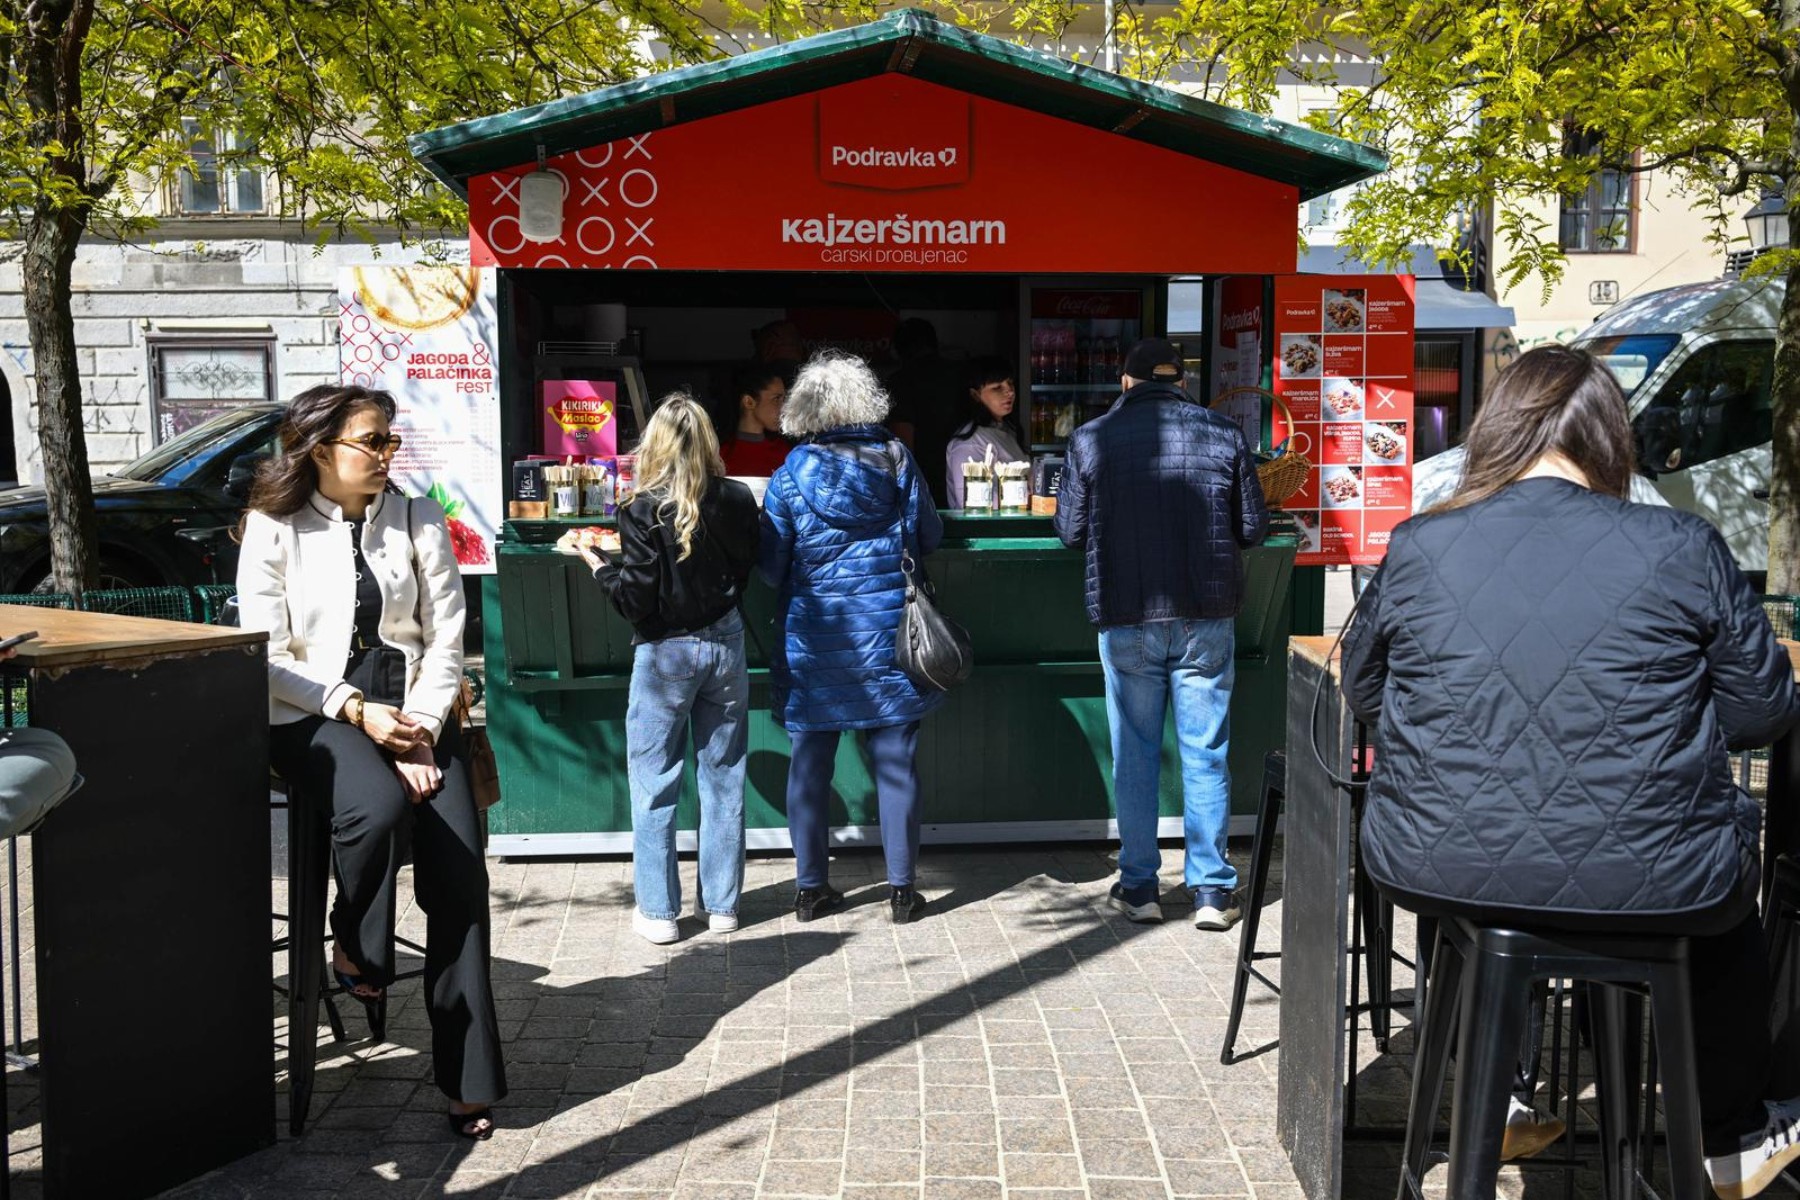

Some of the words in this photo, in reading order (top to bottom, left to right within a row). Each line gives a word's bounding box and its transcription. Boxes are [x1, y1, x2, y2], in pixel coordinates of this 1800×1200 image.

[832, 146, 936, 167] Podravka
[1056, 295, 1112, 315] Coca-Cola
[1222, 308, 1253, 330] Podravka
[472, 342, 491, 366] &
[561, 400, 602, 411] KIKIRIKI
